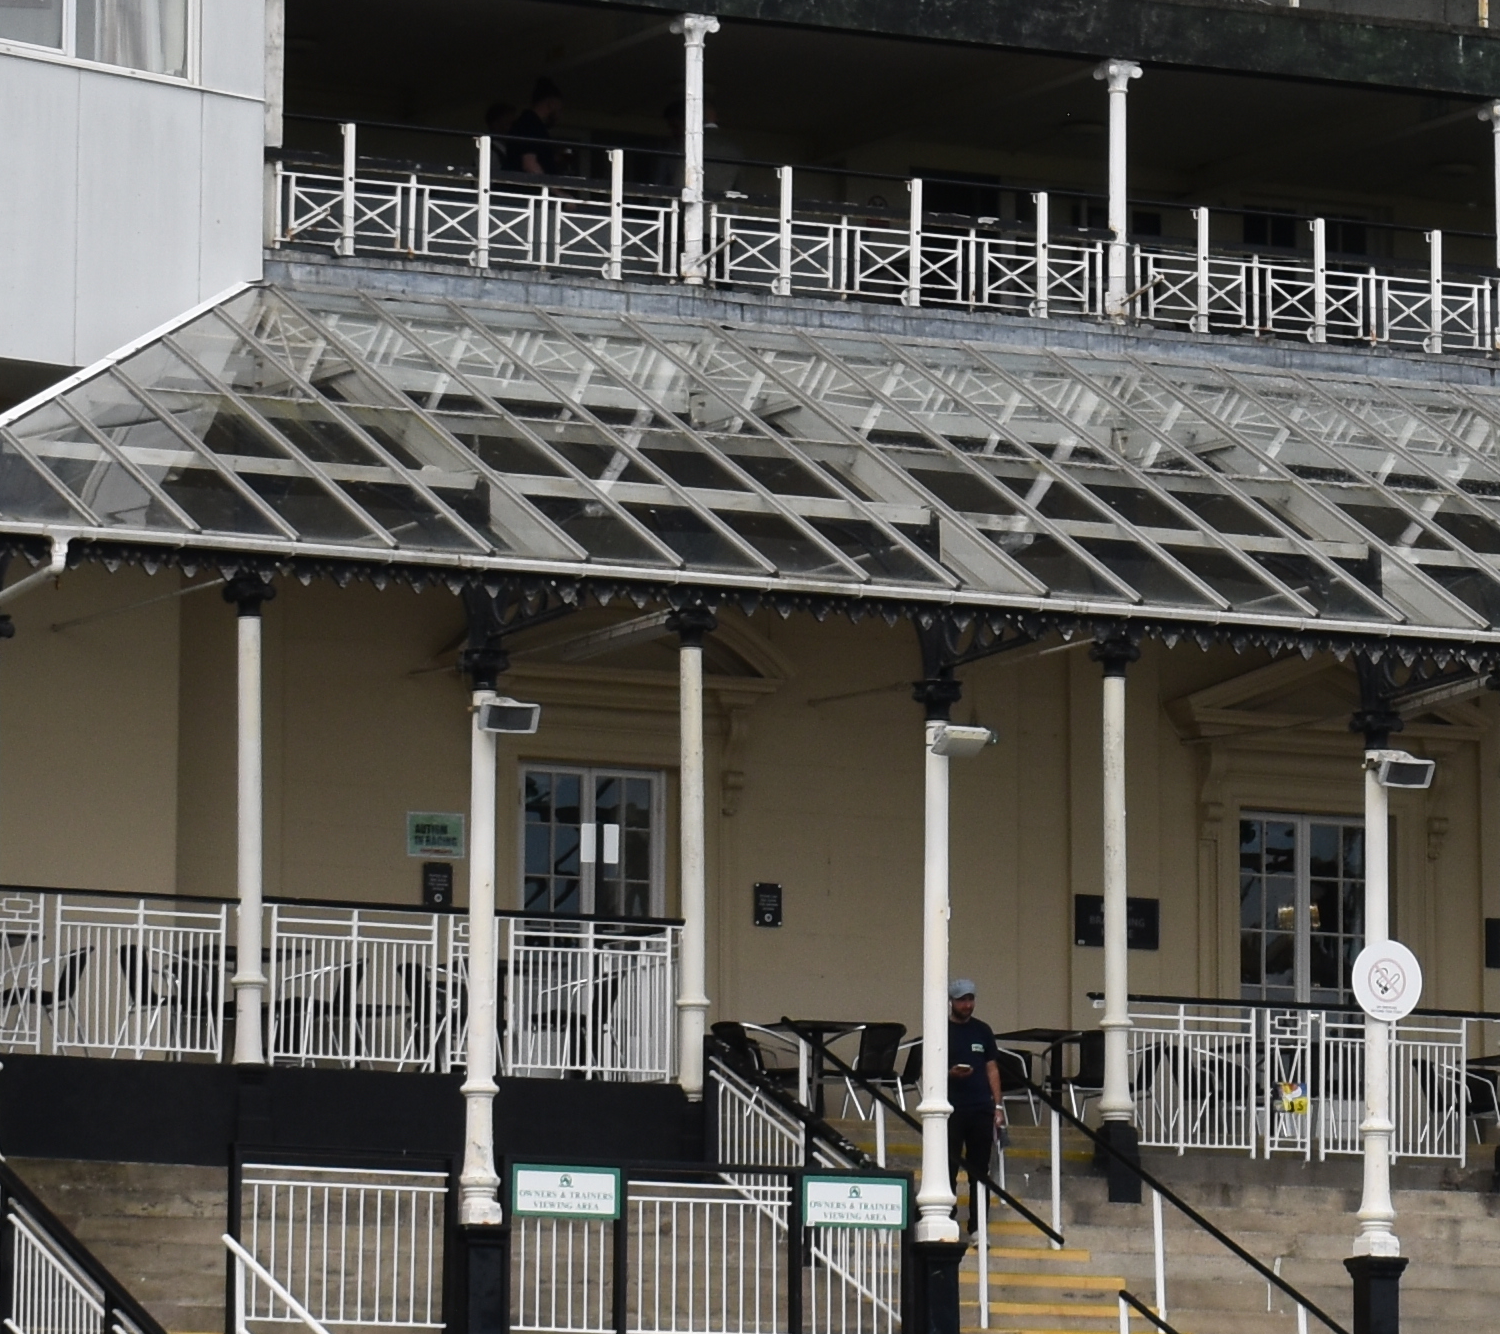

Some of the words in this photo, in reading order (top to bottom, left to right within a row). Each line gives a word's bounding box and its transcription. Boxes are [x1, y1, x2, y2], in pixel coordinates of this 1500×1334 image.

[519, 1189, 559, 1201] OWNERS
[569, 1191, 614, 1202] TRAINERS
[809, 1200, 847, 1212] OWNERS
[857, 1202, 902, 1213] TRAINERS
